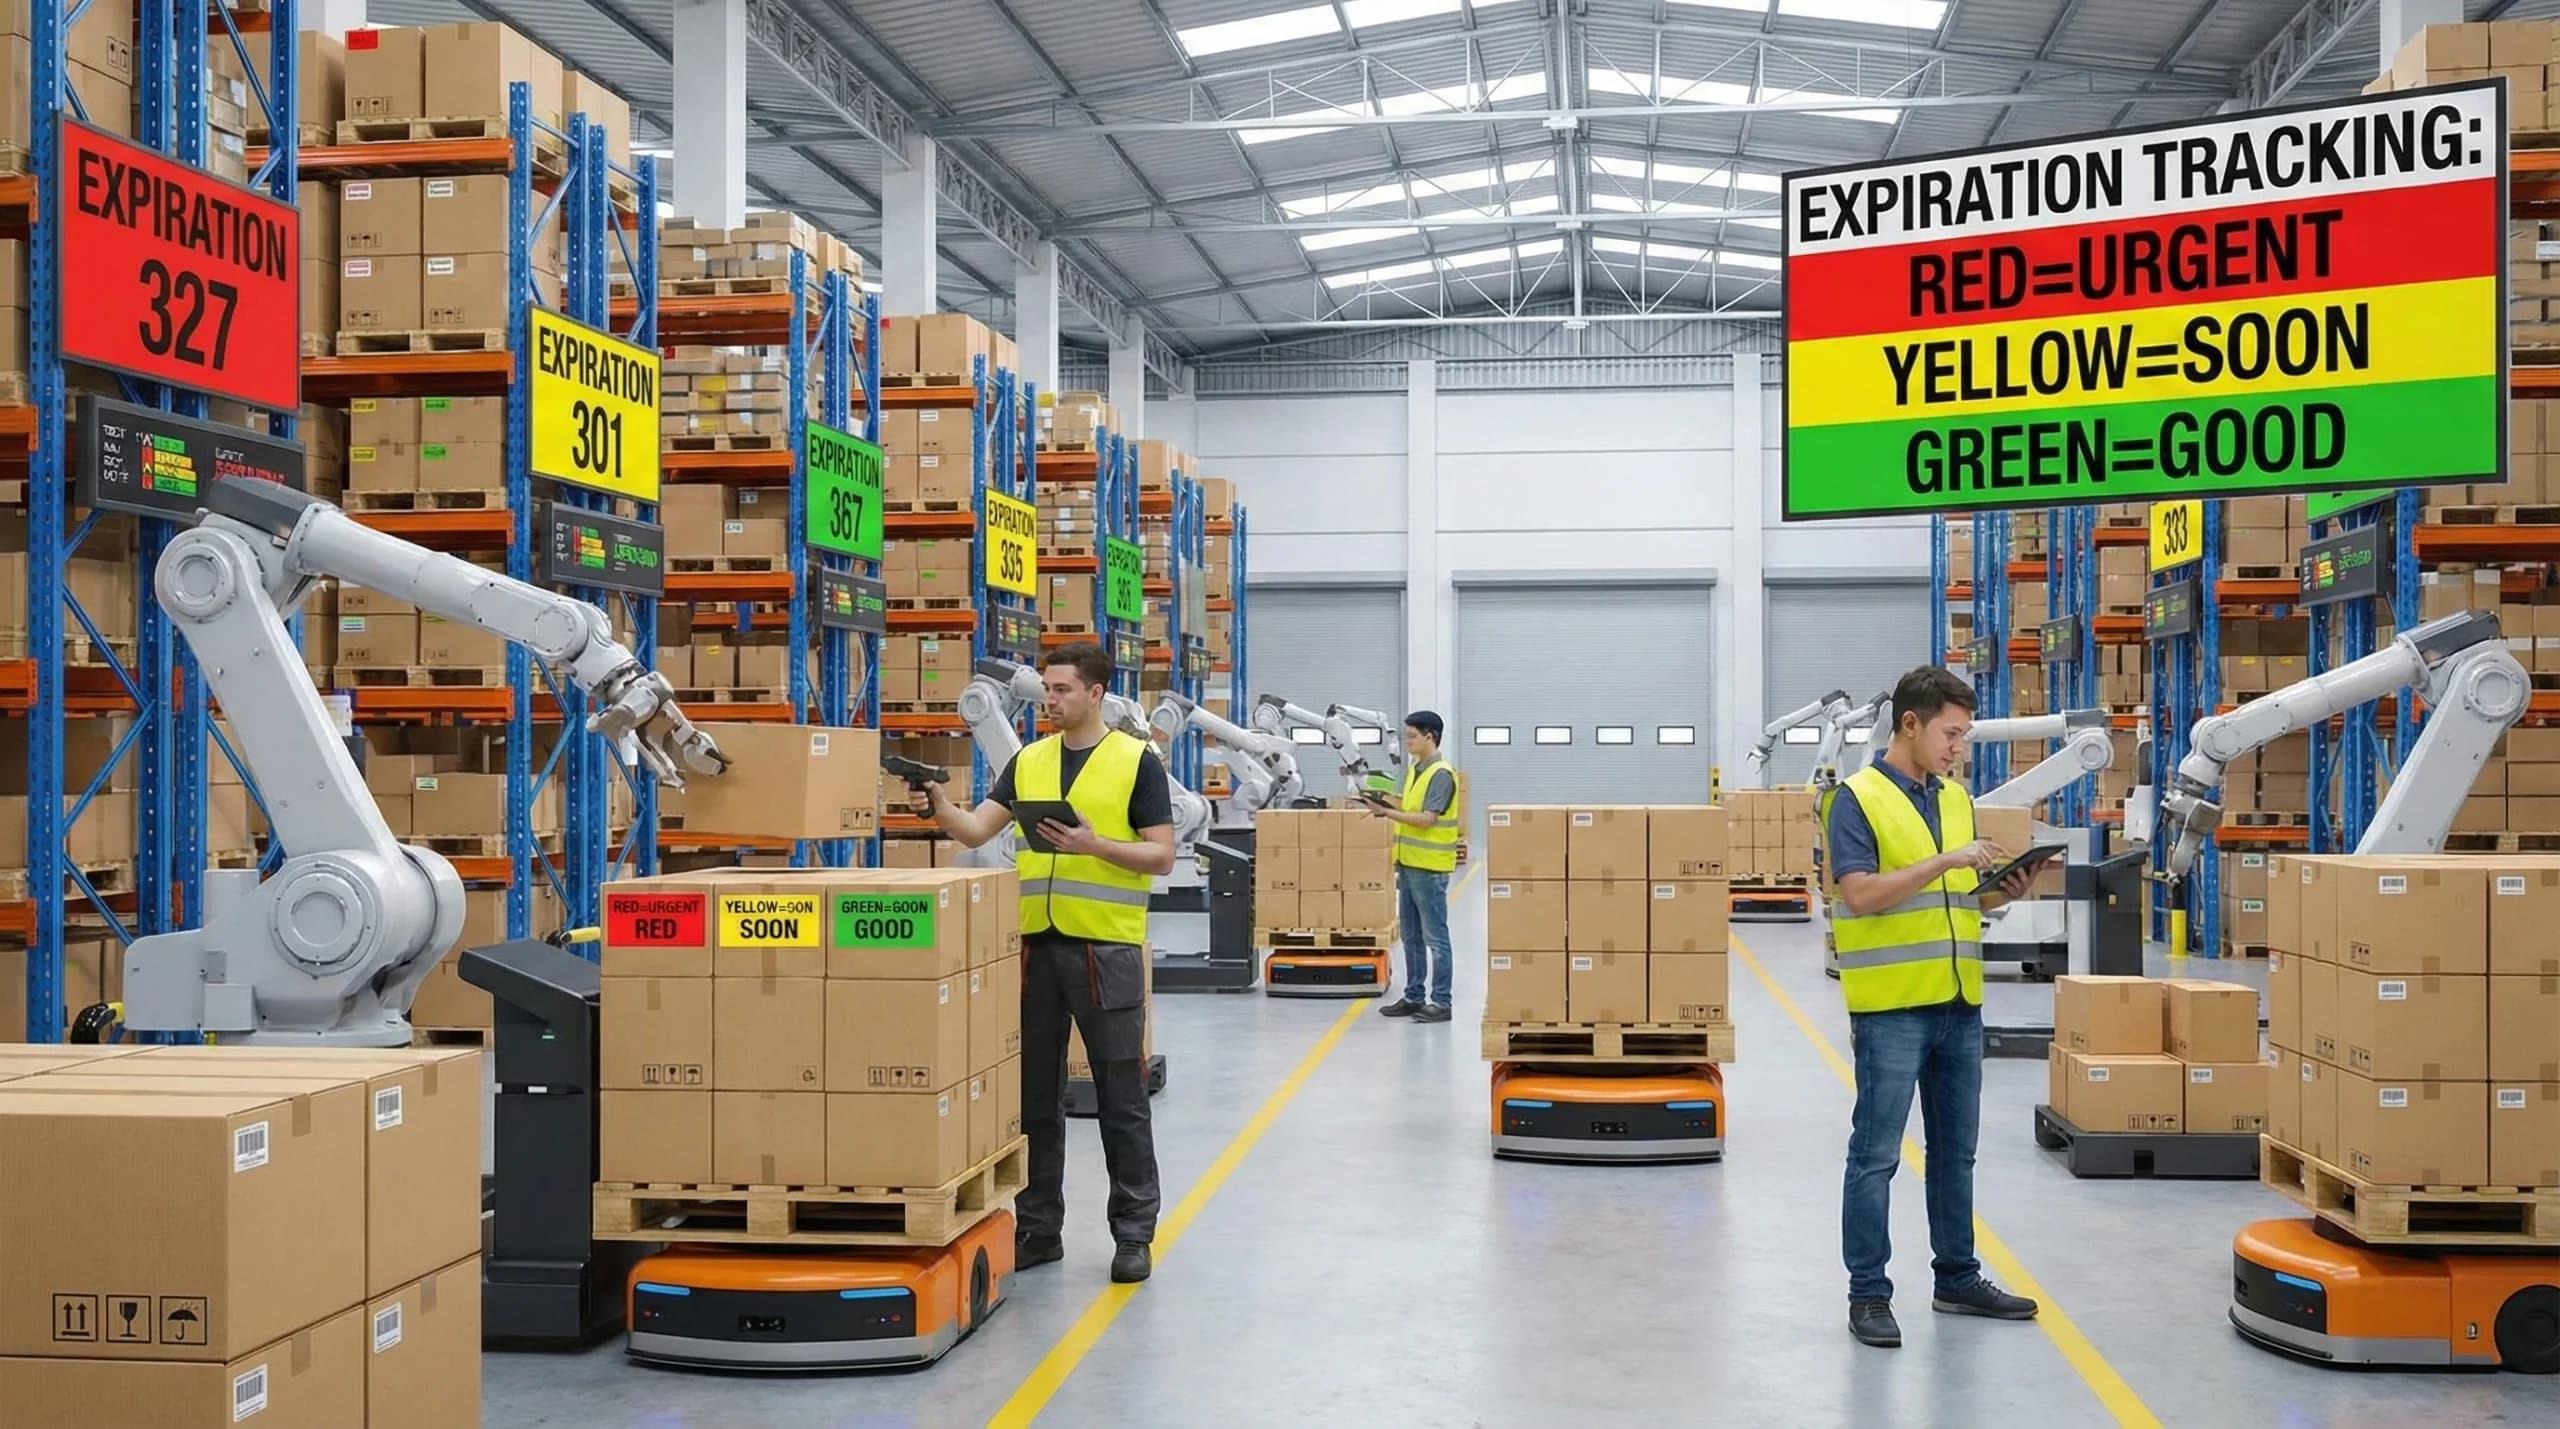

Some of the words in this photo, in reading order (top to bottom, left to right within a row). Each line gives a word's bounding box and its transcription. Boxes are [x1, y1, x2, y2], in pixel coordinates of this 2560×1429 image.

[1799, 149, 2123, 243] EXPIRATION
[2142, 105, 2483, 202] TRACKING:
[78, 147, 286, 282] EXPIRATION
[1909, 209, 2344, 317] RED=URGENT
[138, 258, 238, 371] 327
[539, 325, 653, 408] EXPIRATION
[1882, 302, 2369, 406] YELLOW=SOON
[572, 400, 621, 479] 301
[810, 433, 879, 488] EXPIRATION
[1905, 402, 2346, 494] GREEN=GOOD
[830, 486, 863, 542] 367
[2163, 504, 2188, 556] 333
[1001, 538, 1023, 583] 335
[613, 900, 700, 914] RED=URGENT
[634, 918, 677, 940] RED
[740, 918, 799, 940] SOON
[854, 918, 914, 940] GOOD
